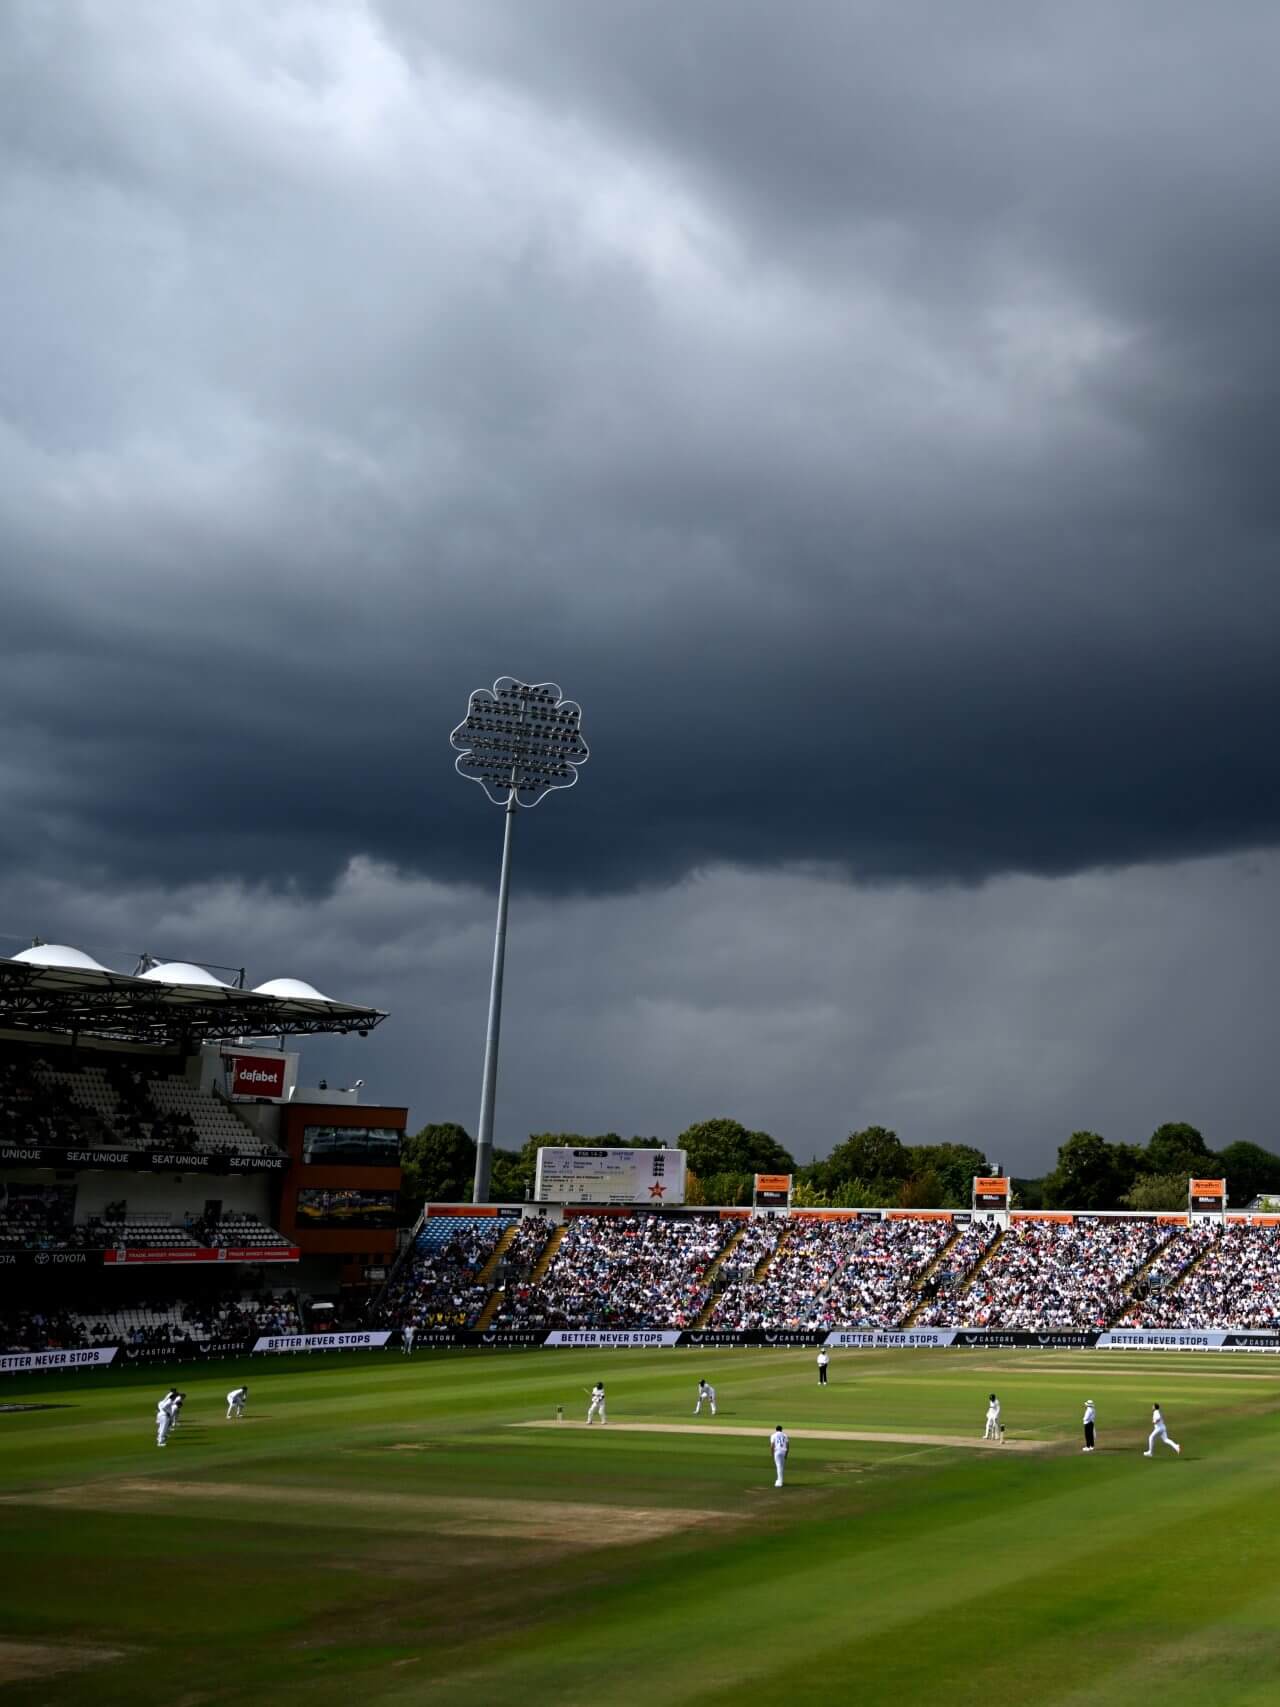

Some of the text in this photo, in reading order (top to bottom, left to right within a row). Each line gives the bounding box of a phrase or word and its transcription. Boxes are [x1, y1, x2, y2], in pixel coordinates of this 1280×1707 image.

[240, 1068, 278, 1083] dafabet
[1, 1149, 41, 1160] UNIQUE
[66, 1151, 129, 1163] SEAT UNIQUE
[152, 1154, 209, 1166] SEAT UNIQUE
[229, 1157, 282, 1168] SEAT UNIQUE
[52, 1253, 87, 1263] TOYOTA
[268, 1334, 370, 1348] BETTER NEVER STOPS
[417, 1334, 456, 1342] CASTORE
[498, 1334, 536, 1342] CASTORE
[561, 1334, 663, 1342] BETTER NEVER STOPS
[840, 1334, 938, 1343] BETTER NEVER STOPS
[980, 1335, 1014, 1343] CASTORE
[1051, 1335, 1087, 1343] CASTORE
[1111, 1336, 1208, 1345] BETTER NEVER STOPS
[140, 1347, 176, 1357] CASTORE
[212, 1343, 245, 1351] CASTORE
[0, 1351, 100, 1369] ETTER NEVER STOPS
